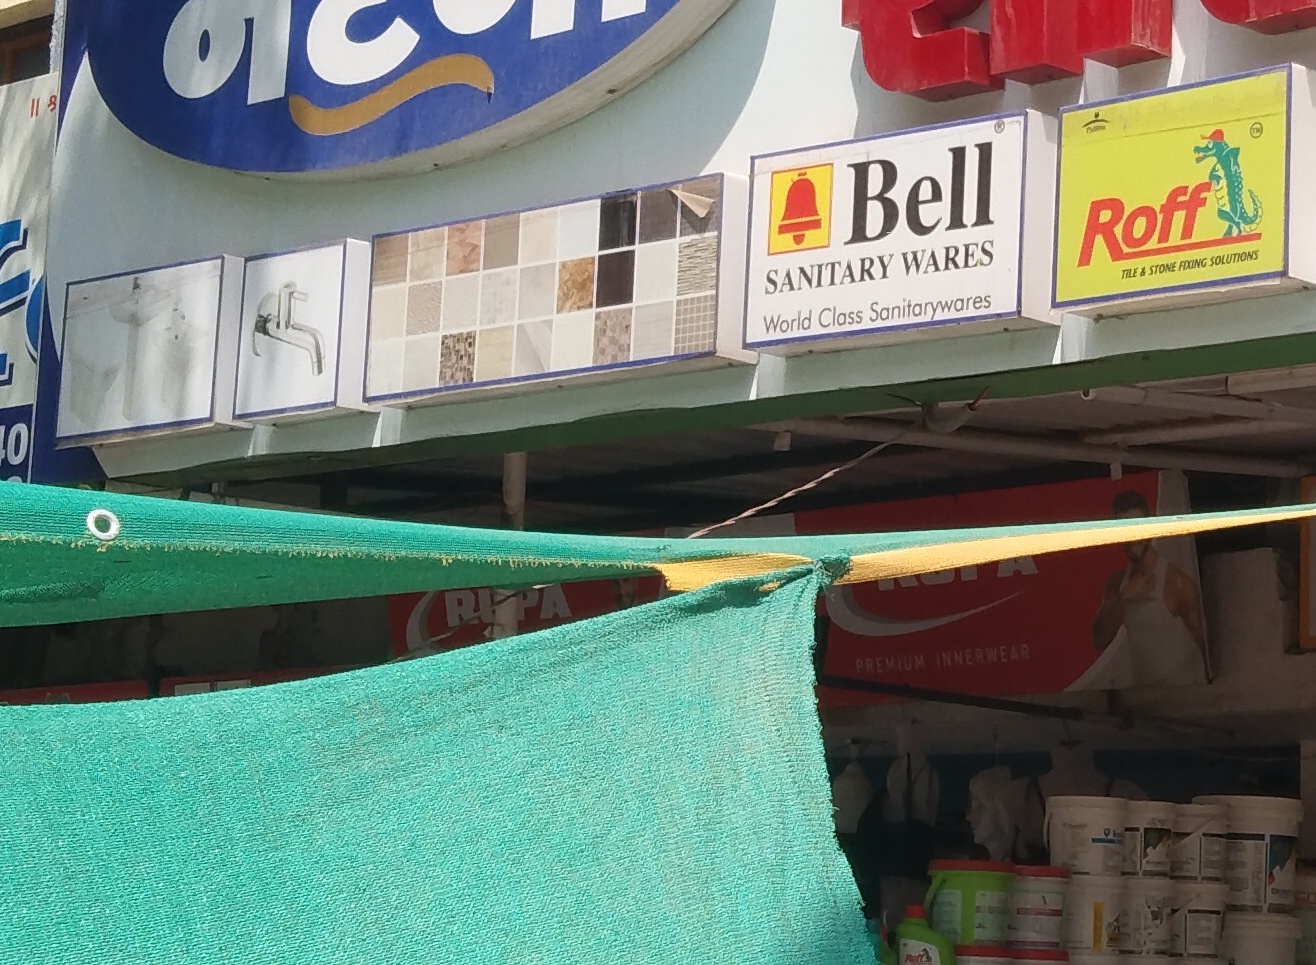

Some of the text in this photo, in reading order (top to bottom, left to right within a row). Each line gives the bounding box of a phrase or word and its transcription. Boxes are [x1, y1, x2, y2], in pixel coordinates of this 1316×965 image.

[842, 141, 995, 246] Bell
[1077, 181, 1214, 269] Roff
[764, 239, 995, 295] SANITARY WARES
[1121, 249, 1260, 280] TILE & STONE FIXING SOLUTIONS
[763, 292, 992, 335] World Class Sanitarywares
[855, 643, 1031, 675] PREMIUM INNERWEAR
